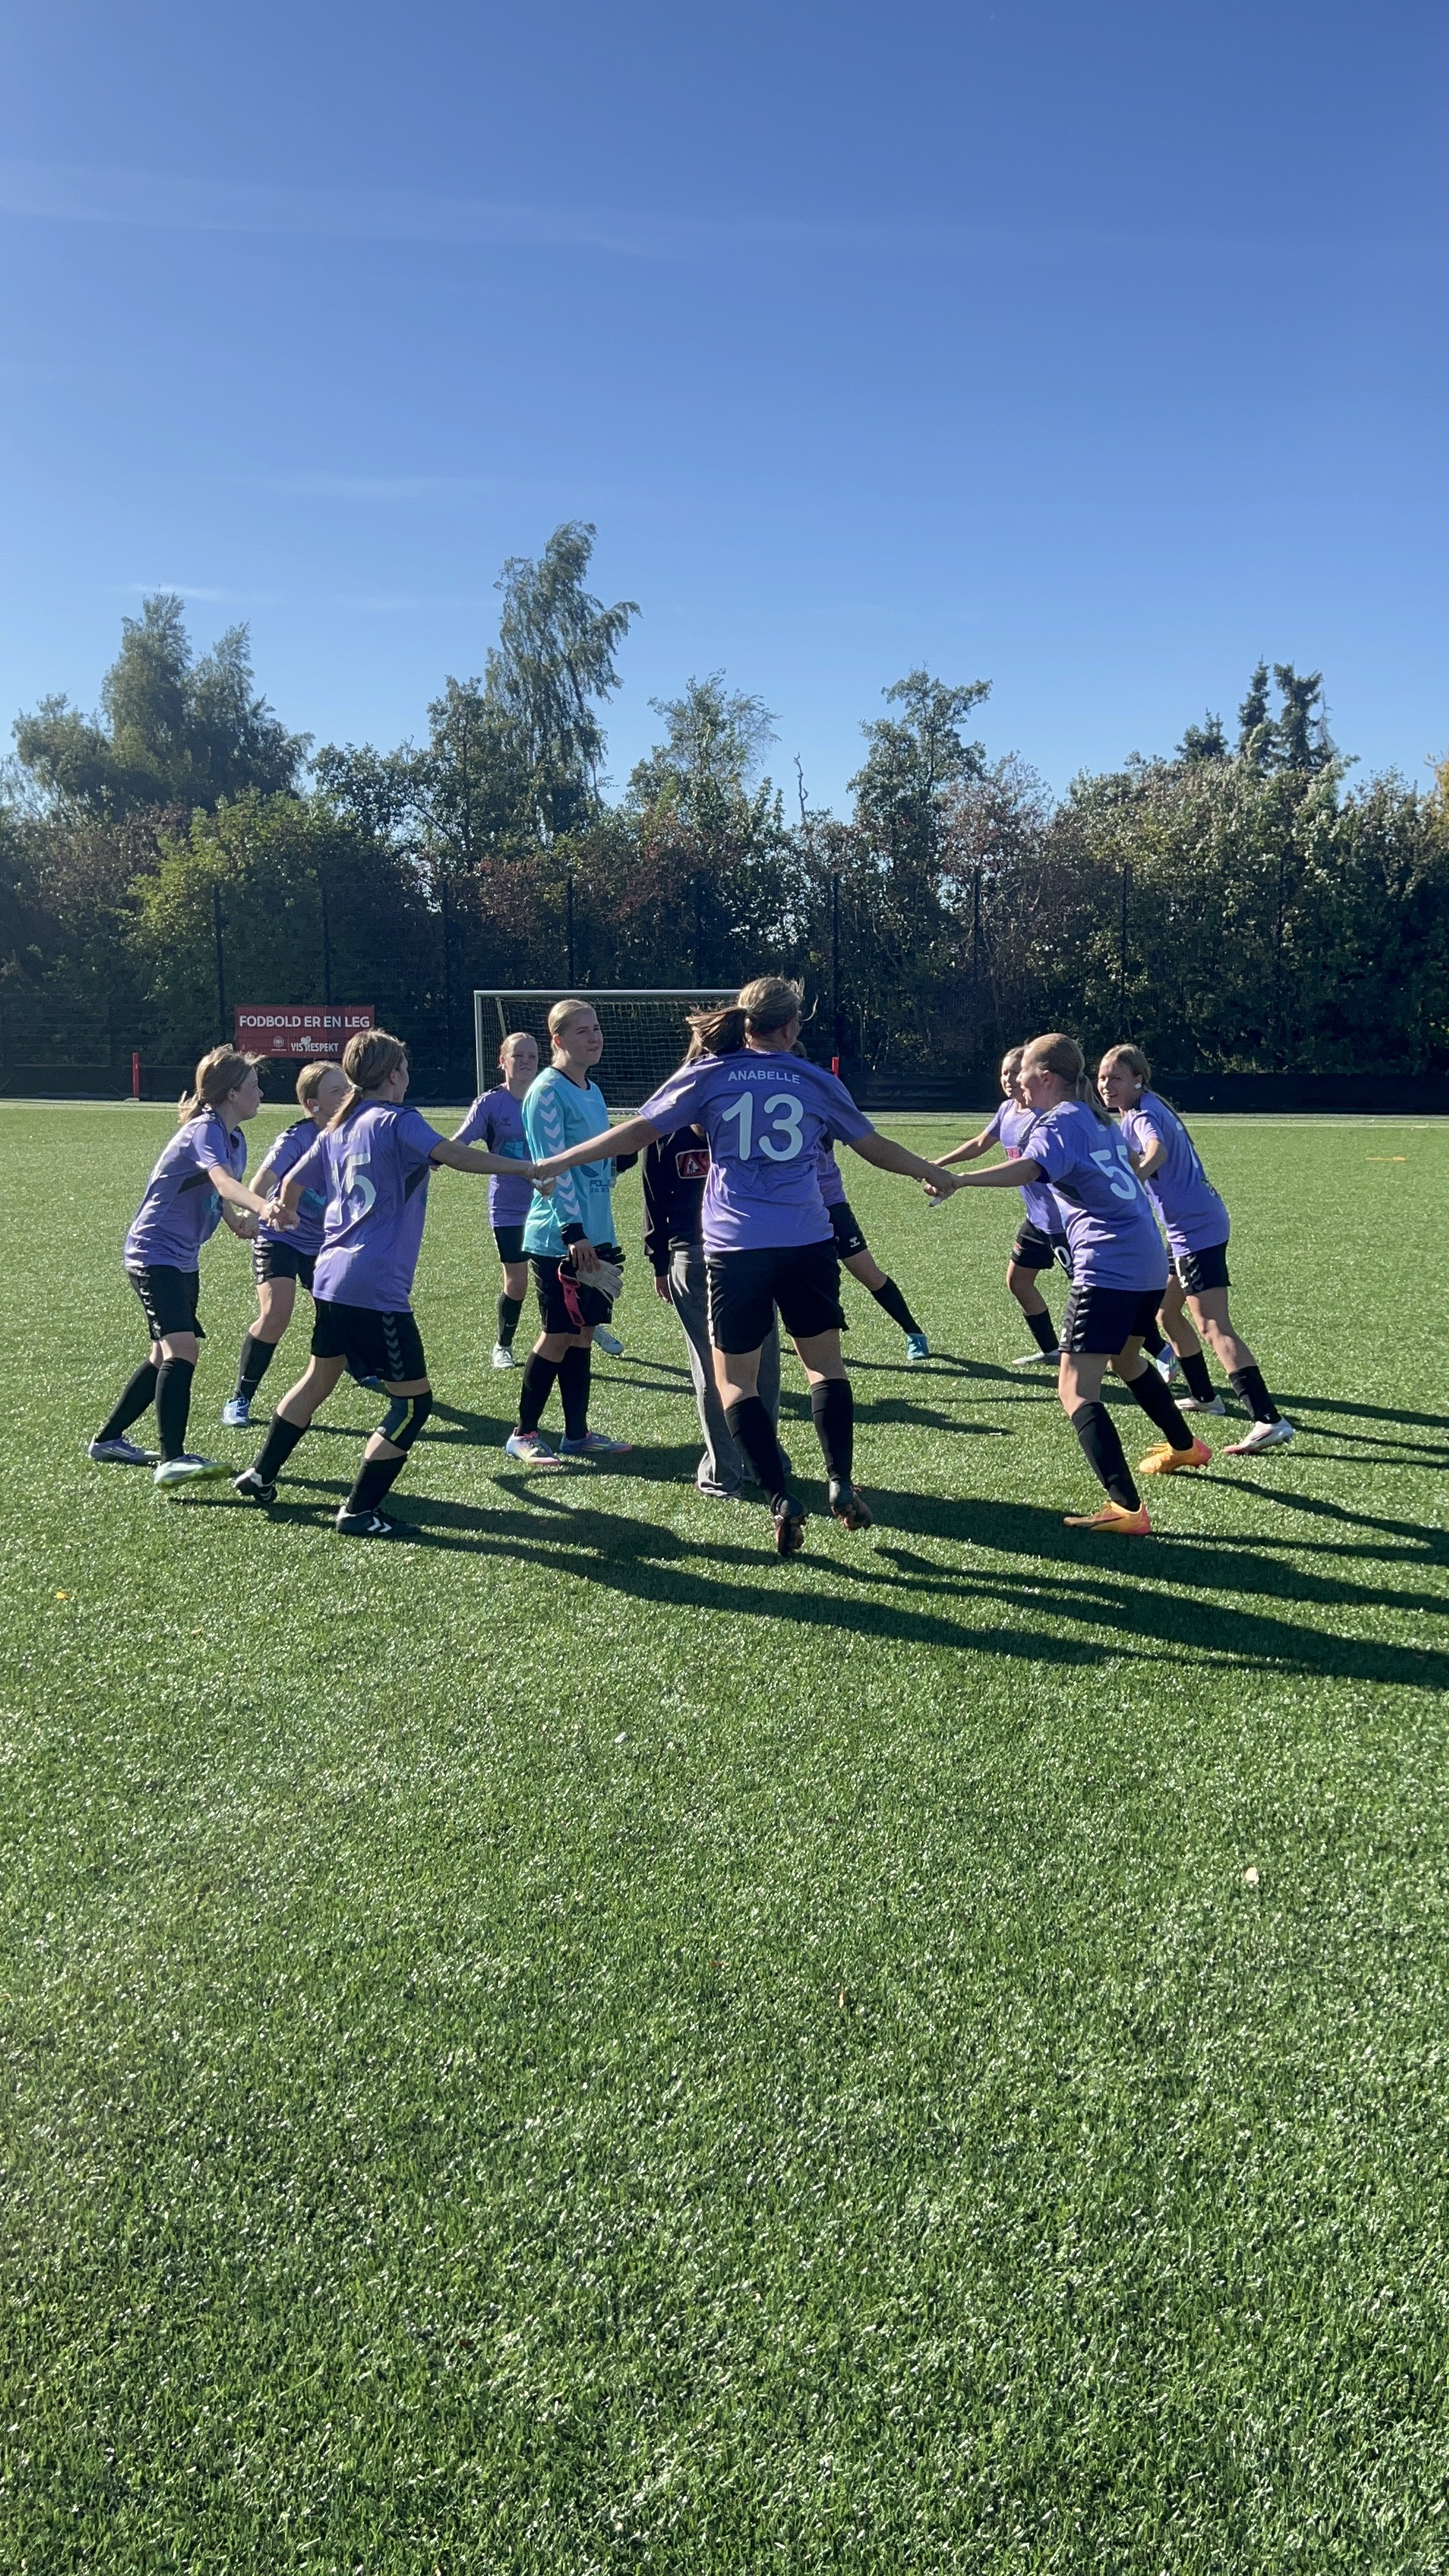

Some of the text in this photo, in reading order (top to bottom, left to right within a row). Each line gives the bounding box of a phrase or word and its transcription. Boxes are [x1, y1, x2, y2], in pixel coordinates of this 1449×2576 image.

[239, 1015, 370, 1027] FODBOLD ER EN LEG
[291, 1042, 339, 1052] VIS RESPEKT
[727, 1070, 801, 1085] ANABELLE
[722, 1091, 804, 1161] 13
